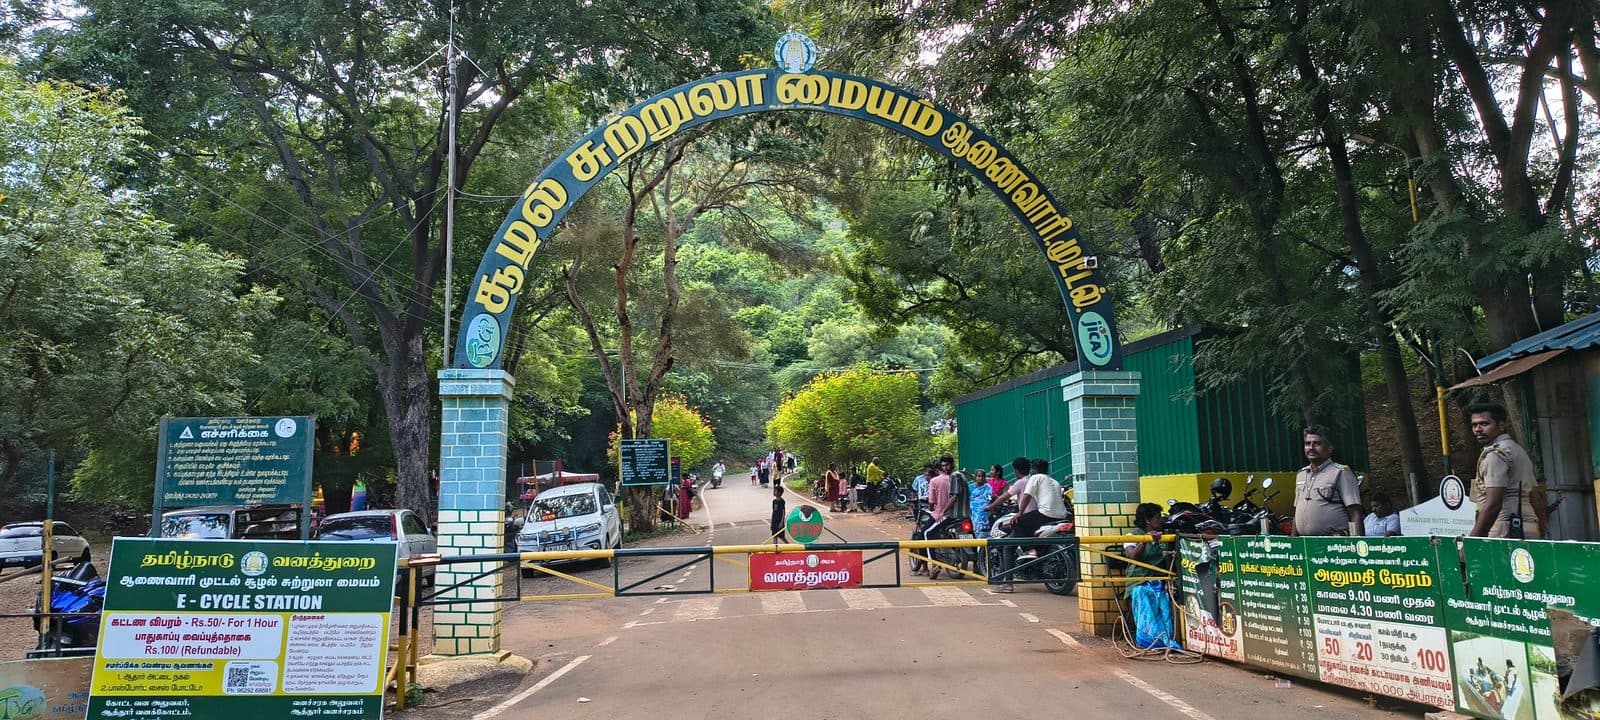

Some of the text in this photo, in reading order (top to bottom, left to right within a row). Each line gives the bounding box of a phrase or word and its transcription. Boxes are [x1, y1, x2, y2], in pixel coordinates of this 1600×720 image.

[475, 178, 568, 314] சூழல்
[566, 73, 768, 181] சுற்றுலா
[775, 73, 943, 137] மையம்
[201, 428, 269, 439] எச்சரிக்கை
[790, 523, 824, 537] STOP
[140, 550, 376, 570] தமிழ்நாடு வனத்துறை
[119, 574, 381, 591] ஆணைவாரி முட்டல் சூழல் சுற்றுலா மையம்
[764, 569, 850, 586] வனத்துறை
[1314, 568, 1433, 590] அனுமதி நேரம்
[177, 594, 186, 608] E
[200, 594, 250, 609] CYCLE
[254, 594, 322, 610] STATION
[1316, 590, 1435, 608] காலை 9.00 மணி முதல்
[1482, 585, 1576, 607] தமிழ்நாடு வனத்துறை
[1317, 604, 1434, 624] மாலை 4.30 மணி வரை
[1493, 604, 1521, 616] முட்டல்
[1522, 607, 1548, 621] சூழல்
[111, 618, 146, 627] கட்டண
[150, 616, 182, 628] விபரம்
[227, 618, 244, 628] For
[247, 618, 251, 627] 1
[254, 618, 278, 628] Hour
[135, 632, 252, 642] பாதுகாப்பு வைப்புத்தொகை
[181, 645, 241, 656] (Refundable)
[1325, 637, 1340, 656] 50
[1356, 641, 1373, 661] 20
[1417, 648, 1446, 673] 100
[1407, 688, 1454, 708] அபராதம்
